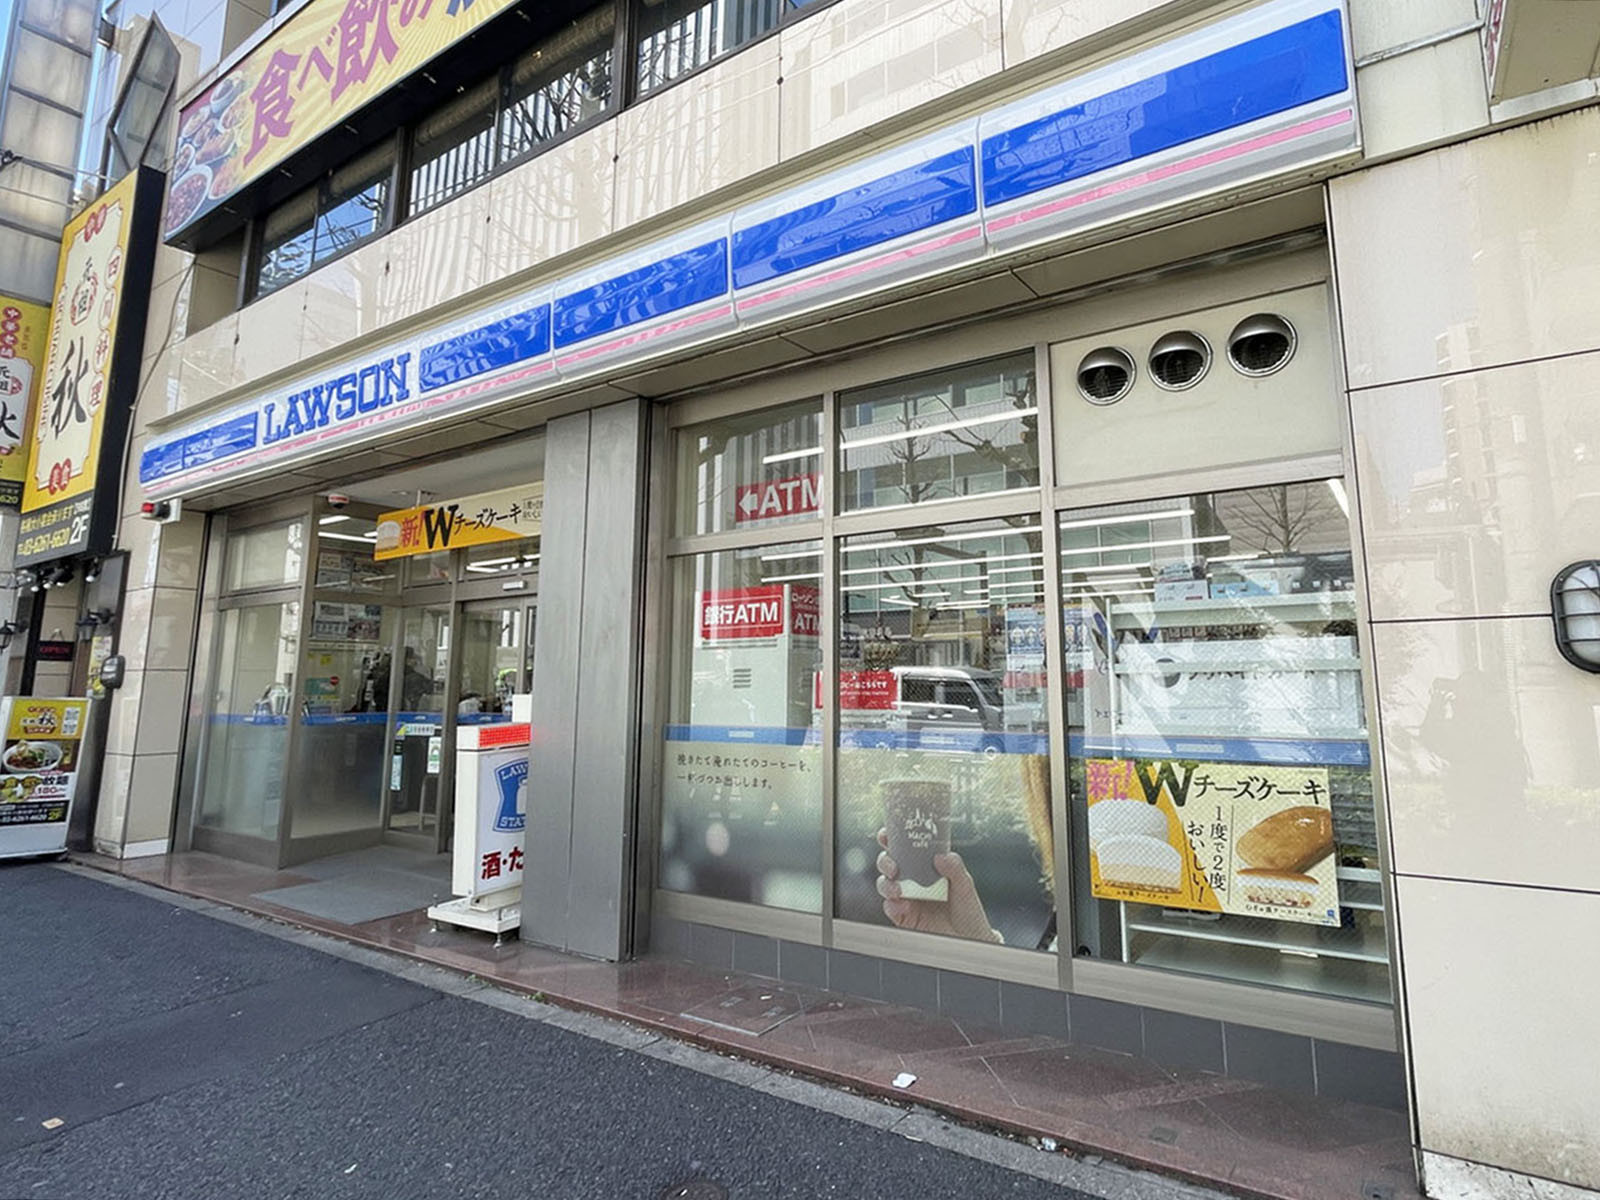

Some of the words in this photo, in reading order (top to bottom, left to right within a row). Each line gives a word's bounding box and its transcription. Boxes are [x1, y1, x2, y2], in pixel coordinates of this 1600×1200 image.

[51, 335, 88, 440] 秋
[262, 351, 411, 446] LAWSON
[69, 514, 90, 545] 2F
[759, 478, 824, 516] ATM
[704, 601, 779, 626] 銀行ATM
[1187, 821, 1209, 903] おいしい!
[1209, 805, 1229, 892] 1度で2度
